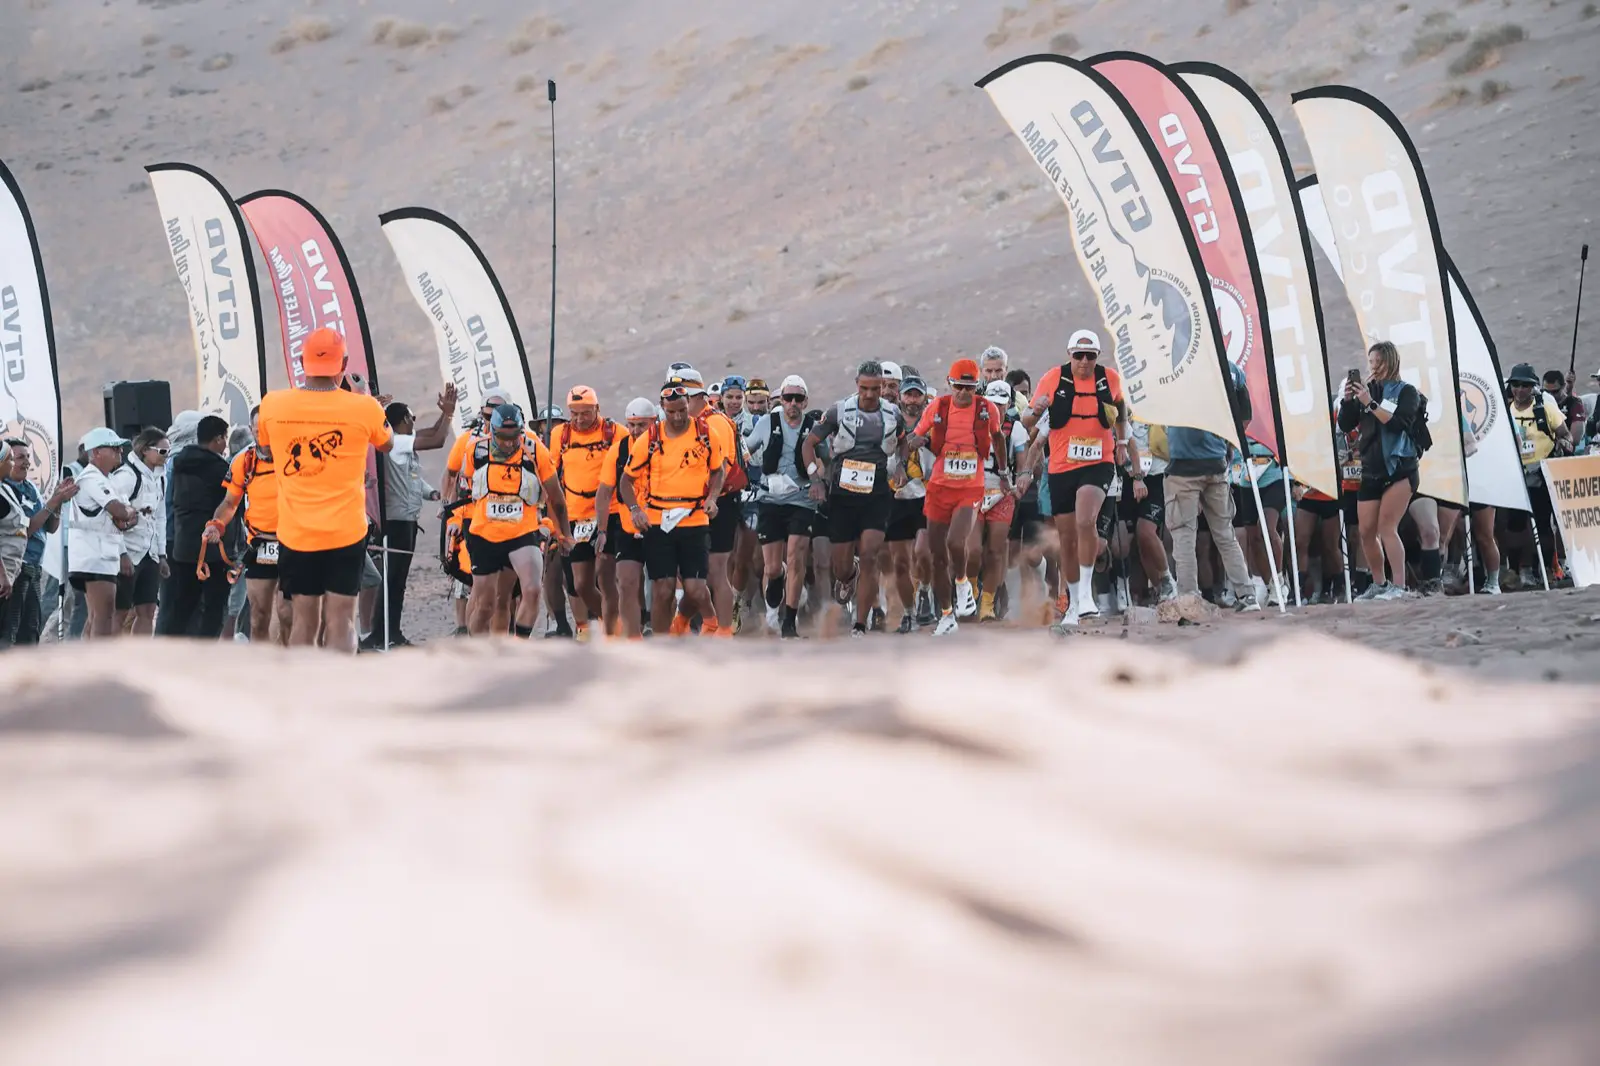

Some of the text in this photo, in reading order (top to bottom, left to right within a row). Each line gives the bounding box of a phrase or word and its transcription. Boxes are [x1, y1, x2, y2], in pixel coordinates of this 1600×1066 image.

[1073, 445, 1092, 457] 118
[949, 460, 968, 470] 119
[851, 471, 858, 481] 2
[1553, 476, 1600, 500] THE ADVE
[491, 504, 513, 514] 166
[1561, 509, 1572, 529] OF
